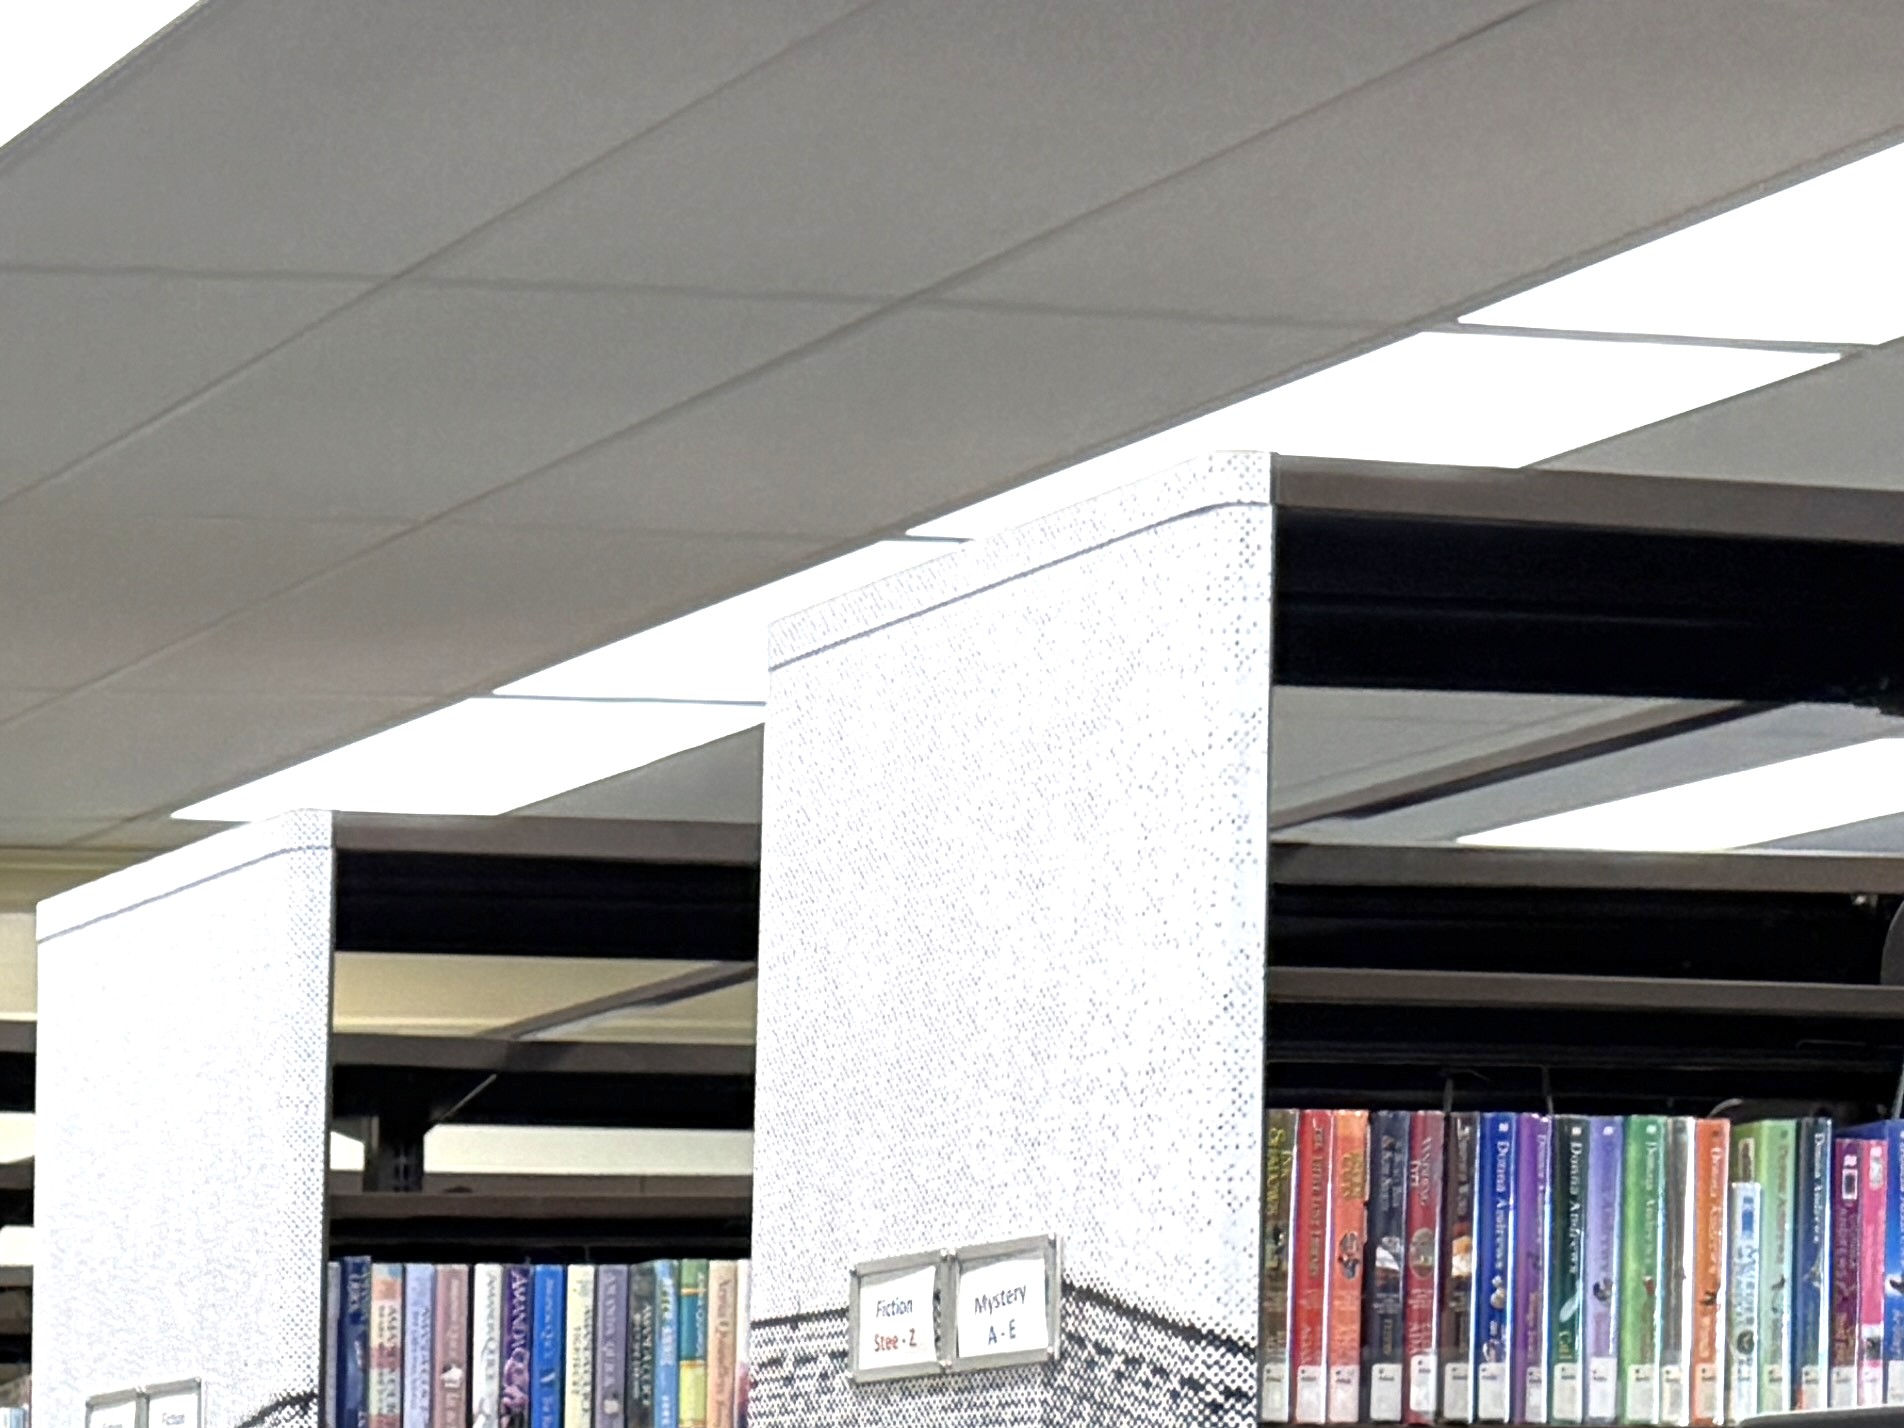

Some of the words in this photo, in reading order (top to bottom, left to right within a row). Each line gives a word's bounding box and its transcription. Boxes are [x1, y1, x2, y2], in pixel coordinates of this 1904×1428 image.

[1495, 1140, 1510, 1192] Donna
[1569, 1141, 1581, 1195] Donna
[1569, 1200, 1580, 1275] Andrews
[875, 1298, 914, 1318] Fiction
[974, 1284, 1027, 1315] Mystery
[987, 1326, 998, 1345] A
[1008, 1319, 1017, 1340] E
